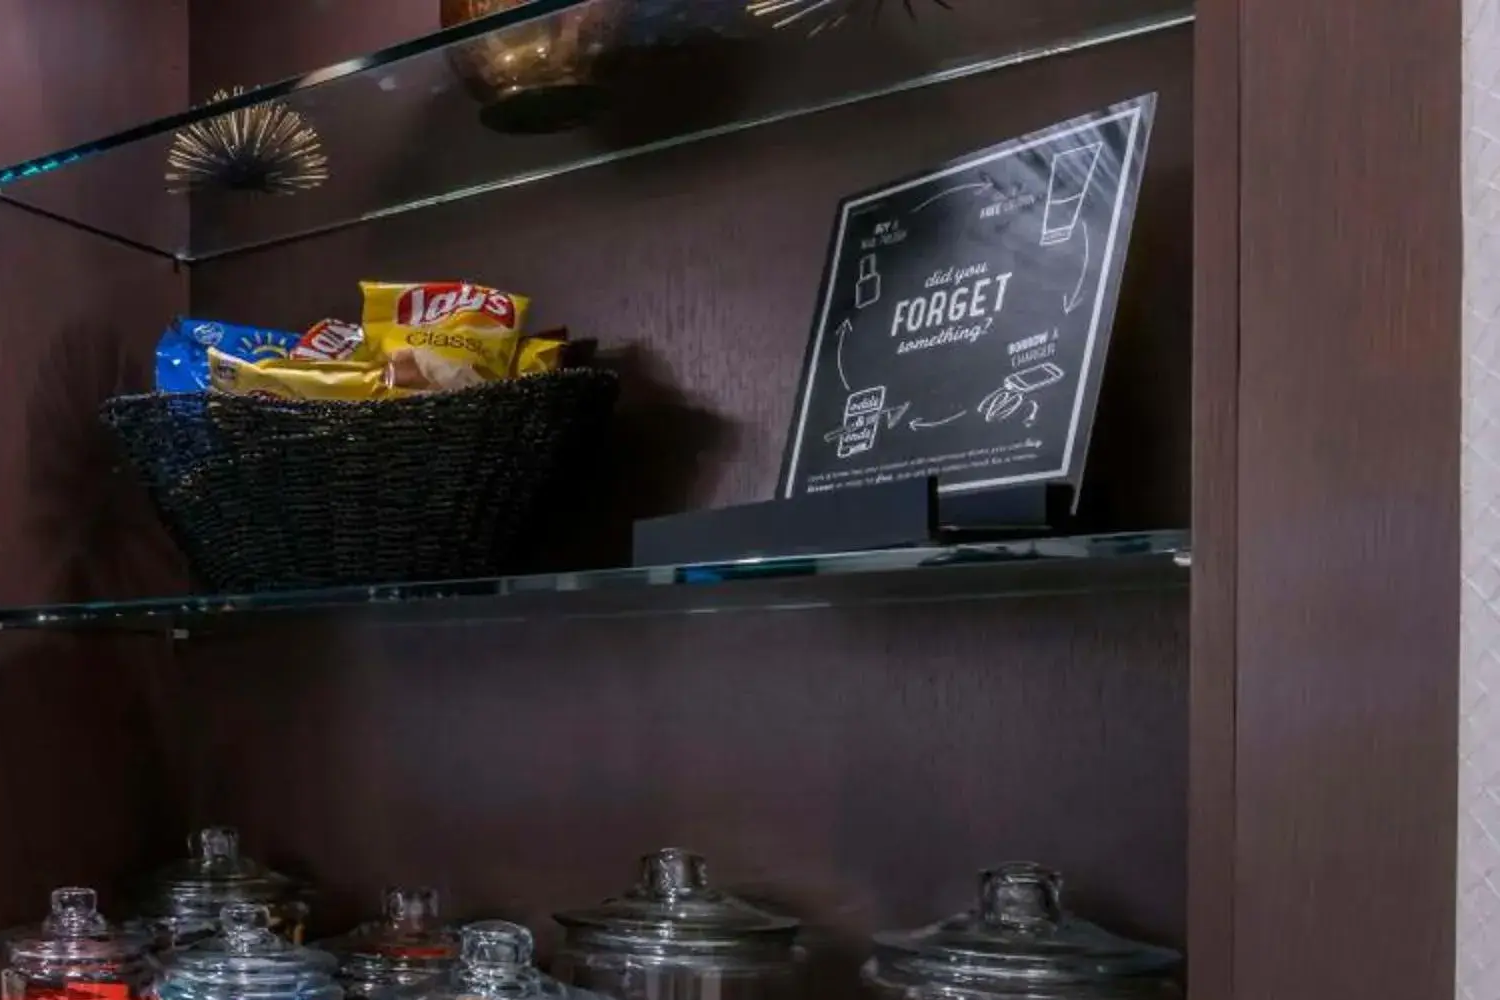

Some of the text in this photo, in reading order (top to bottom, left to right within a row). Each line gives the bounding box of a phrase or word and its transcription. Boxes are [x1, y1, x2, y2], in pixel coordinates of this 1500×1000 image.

[924, 261, 988, 289] did you
[409, 282, 508, 326] Lay's
[891, 271, 1012, 337] FORGET
[896, 316, 994, 355] something?
